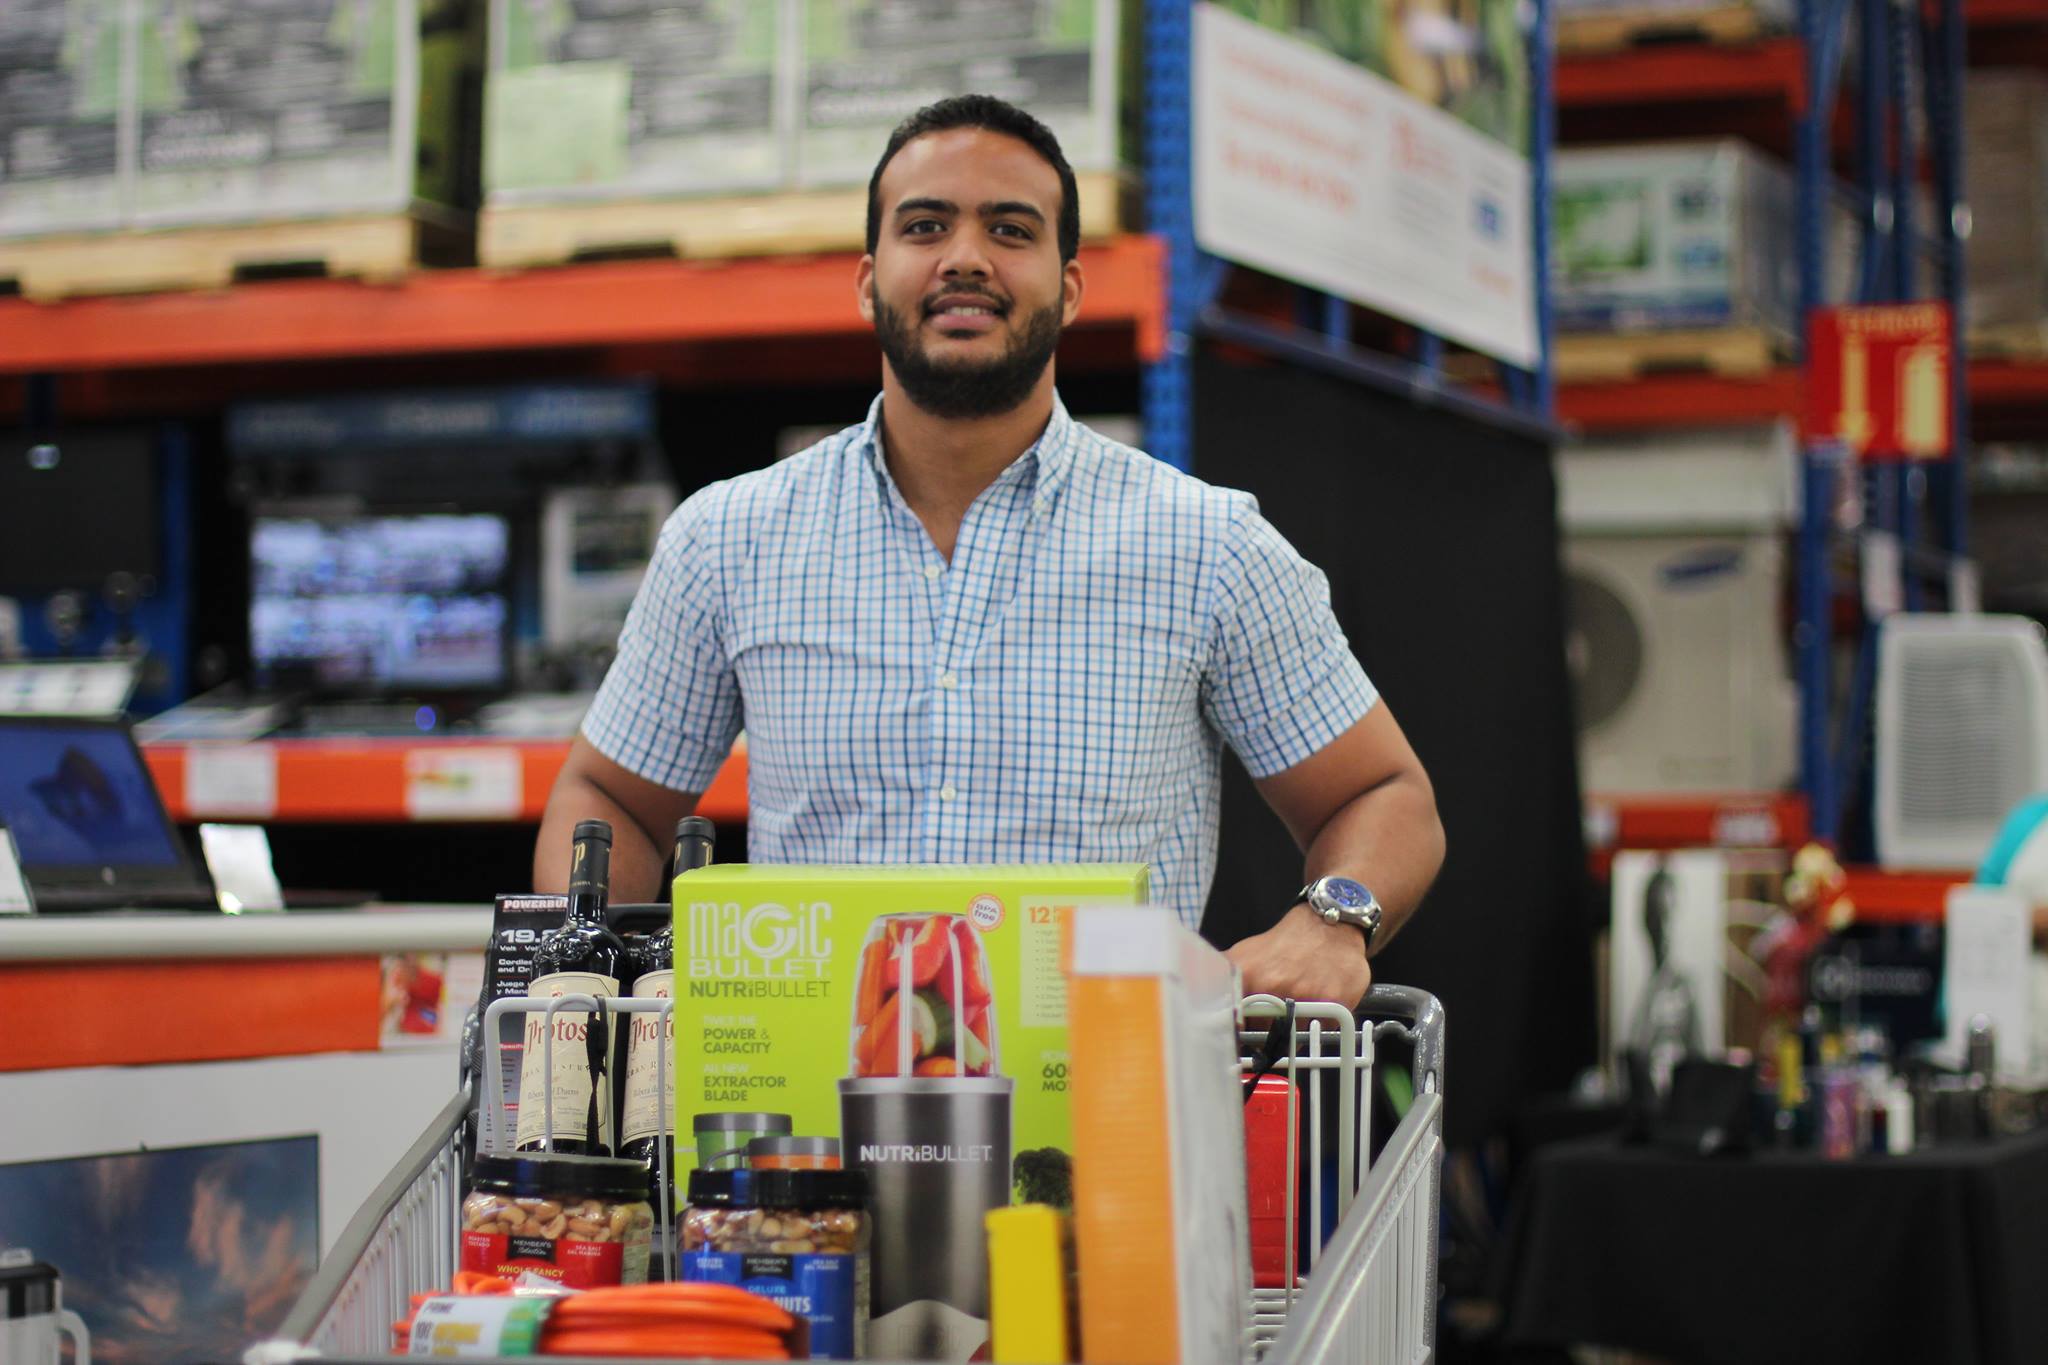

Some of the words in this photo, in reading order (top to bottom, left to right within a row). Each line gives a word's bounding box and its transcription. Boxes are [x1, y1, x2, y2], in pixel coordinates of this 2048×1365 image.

[1029, 907, 1050, 923] 12
[689, 959, 832, 978] BULLET
[497, 981, 525, 989] Juego
[703, 1028, 756, 1040] POWER
[760, 1028, 769, 1040] &
[703, 1042, 772, 1054] CAPACITY
[703, 1076, 787, 1088] EXTRACTOR
[703, 1090, 748, 1101] BLADE
[534, 1266, 565, 1278] FANCY
[748, 1285, 787, 1295] DELUXE
